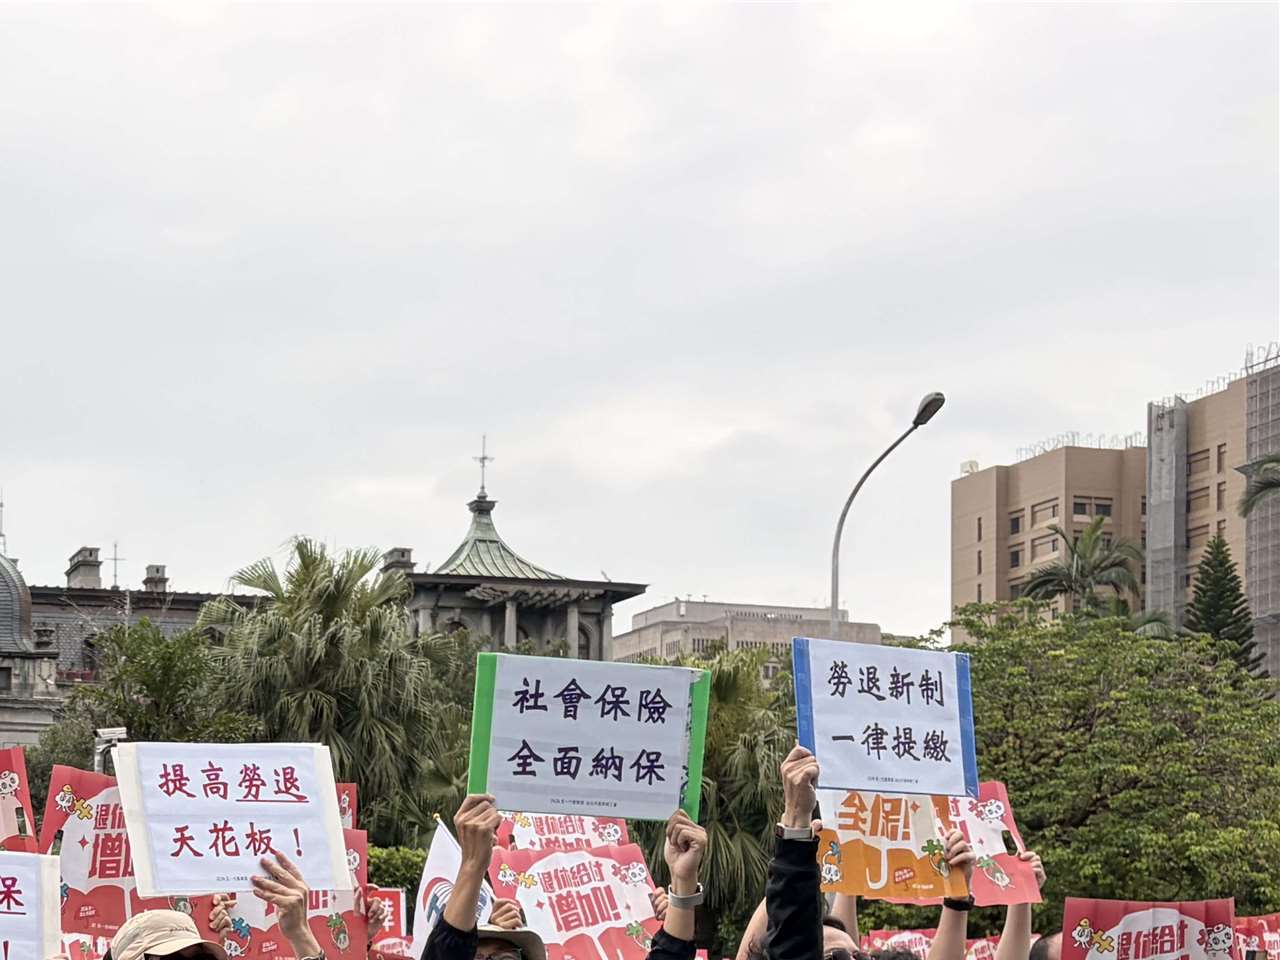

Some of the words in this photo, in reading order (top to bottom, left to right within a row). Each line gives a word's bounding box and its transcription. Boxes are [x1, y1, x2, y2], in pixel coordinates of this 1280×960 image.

[512, 677, 673, 724] 社會保險
[828, 660, 945, 707] 勞退新制
[507, 739, 666, 786] 全面納保
[831, 722, 951, 763] 一律提繳
[158, 761, 310, 802] 提高勞退
[171, 820, 303, 859] 天花板！
[538, 860, 606, 894] 退休給付
[547, 884, 622, 933] 增加!
